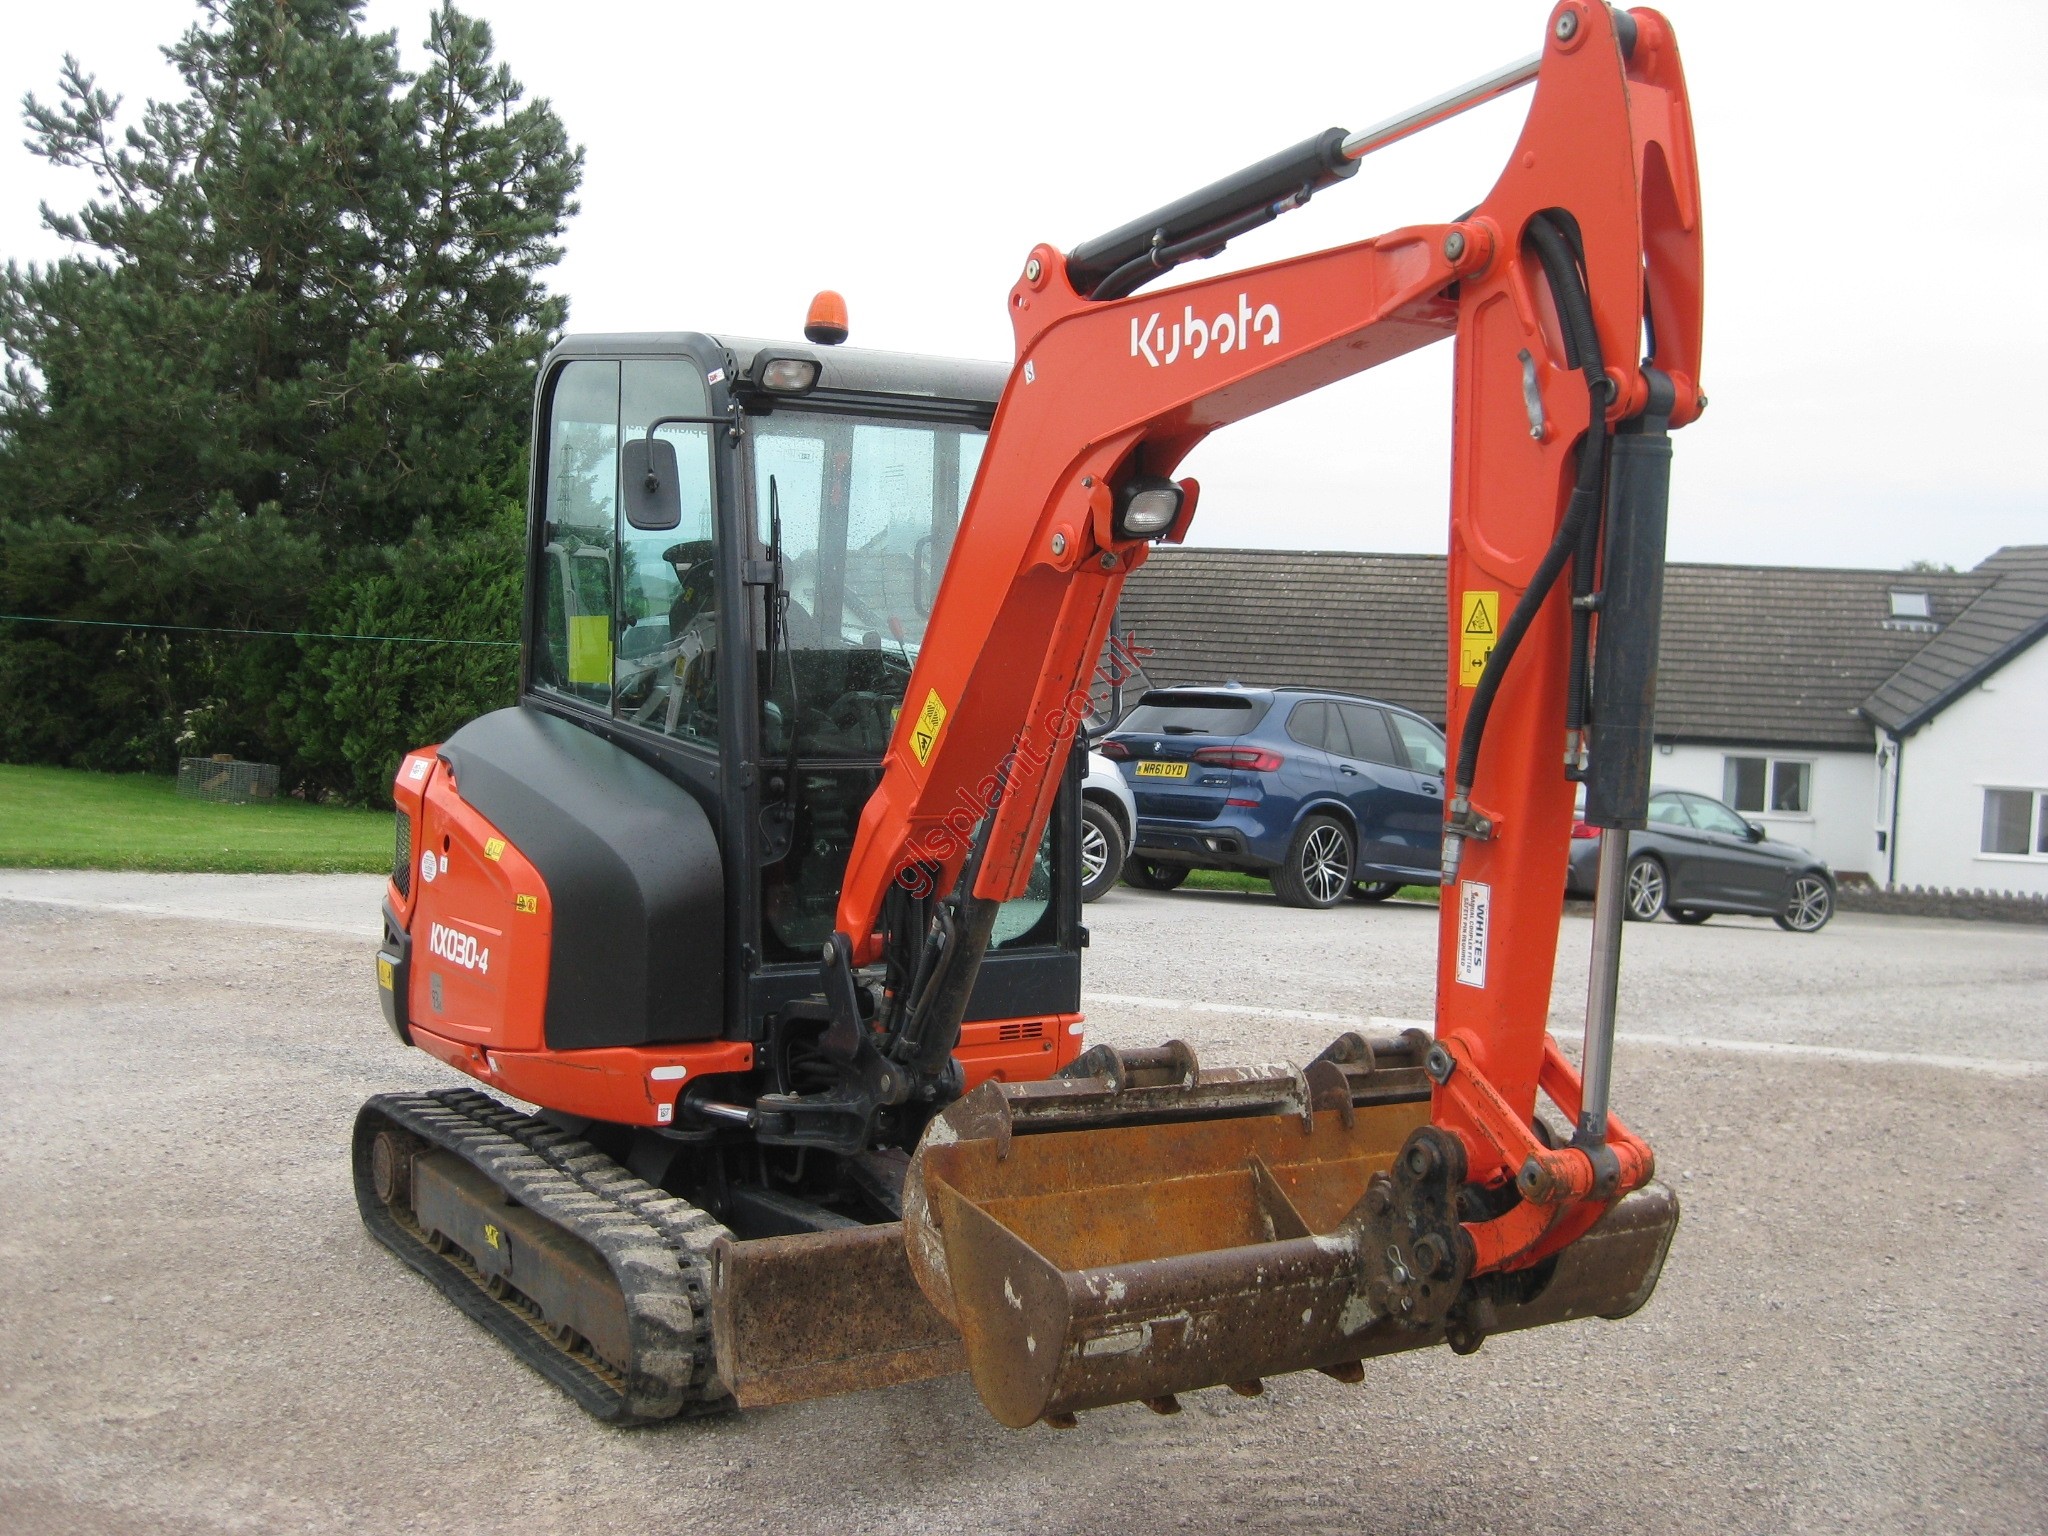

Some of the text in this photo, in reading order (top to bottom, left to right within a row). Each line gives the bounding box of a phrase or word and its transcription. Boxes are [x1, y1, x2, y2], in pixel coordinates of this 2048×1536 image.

[1130, 293, 1280, 367] Kubota
[1165, 764, 1184, 775] OYD
[430, 921, 489, 975] KX030-4
[1467, 920, 1475, 950] COUPLER
[1474, 904, 1485, 967] WHITES
